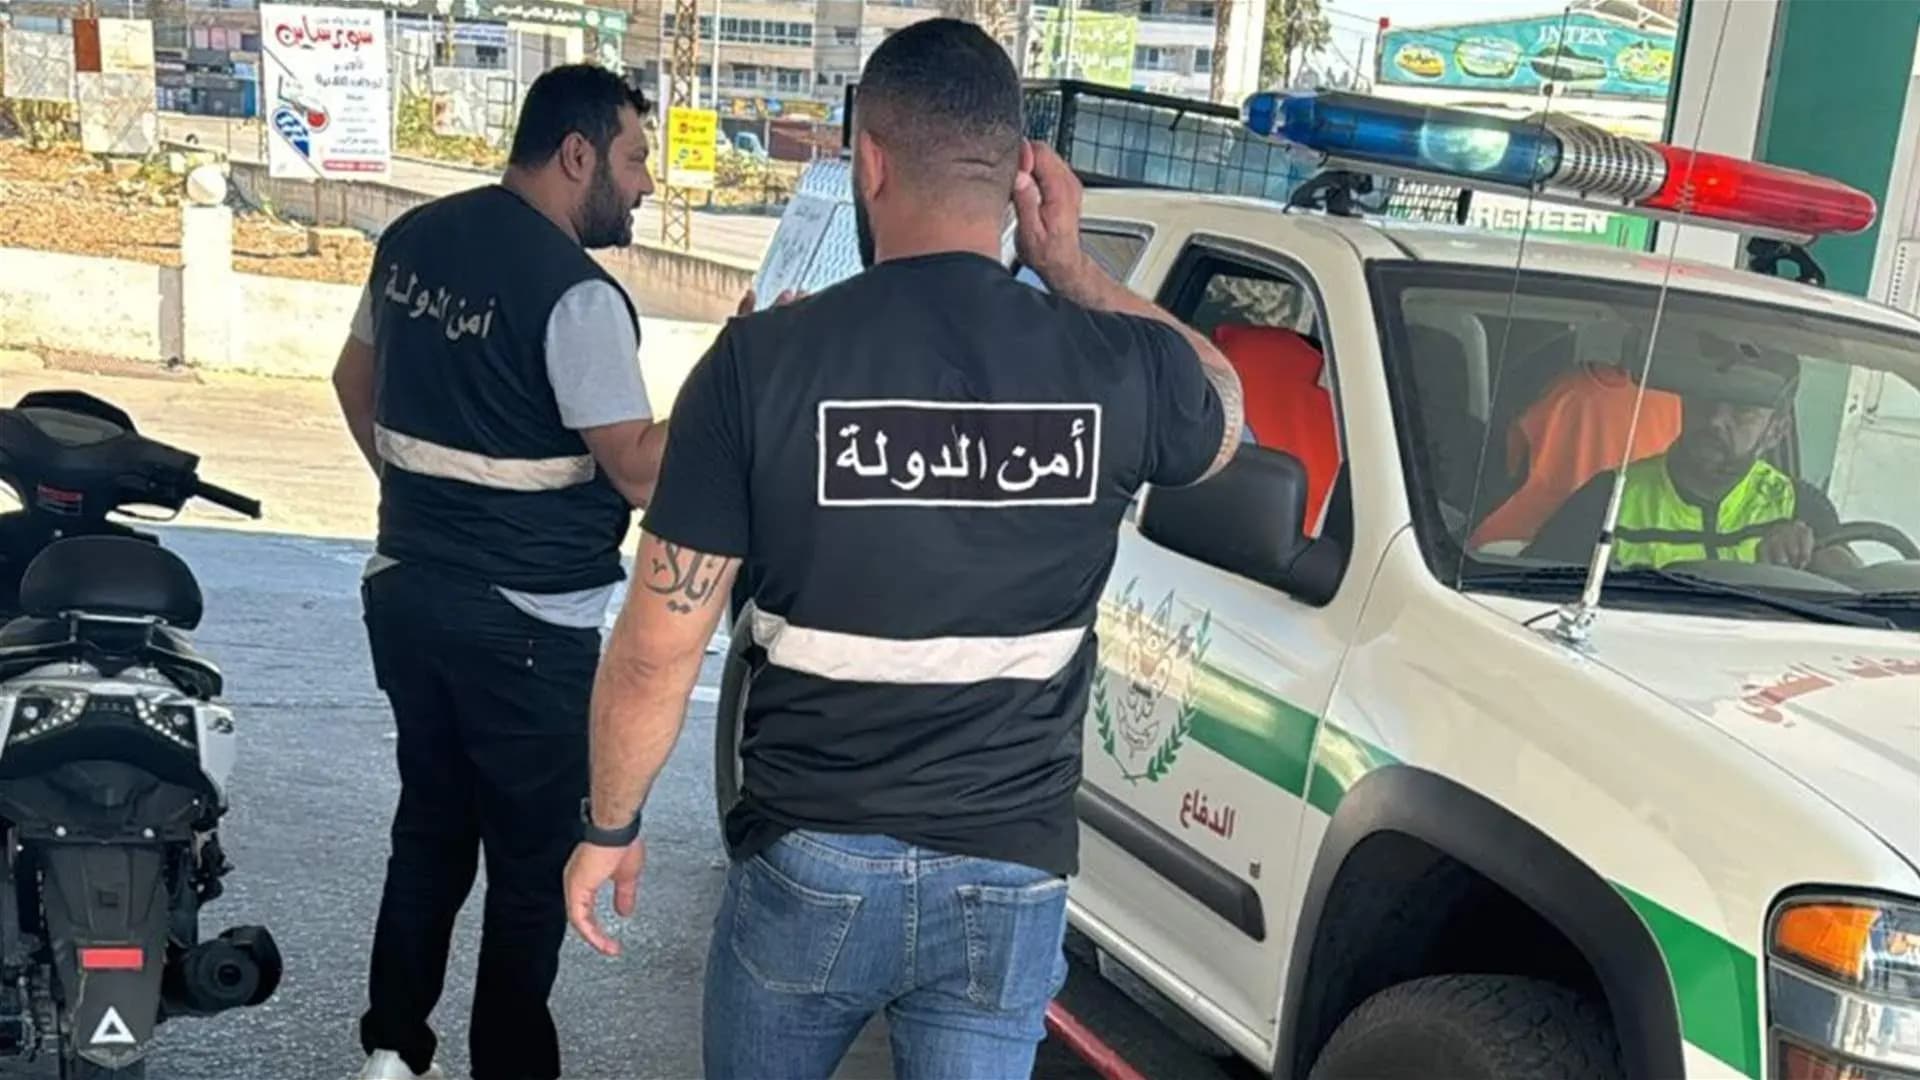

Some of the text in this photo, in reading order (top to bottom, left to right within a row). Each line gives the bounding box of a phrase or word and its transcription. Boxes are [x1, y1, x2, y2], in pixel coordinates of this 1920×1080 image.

[1536, 25, 1608, 46] INTEX
[1474, 203, 1608, 234] RGREEN
[384, 263, 450, 319] الدولة
[836, 418, 1085, 491] أمن الدولة
[1180, 789, 1236, 840] الدفاع
